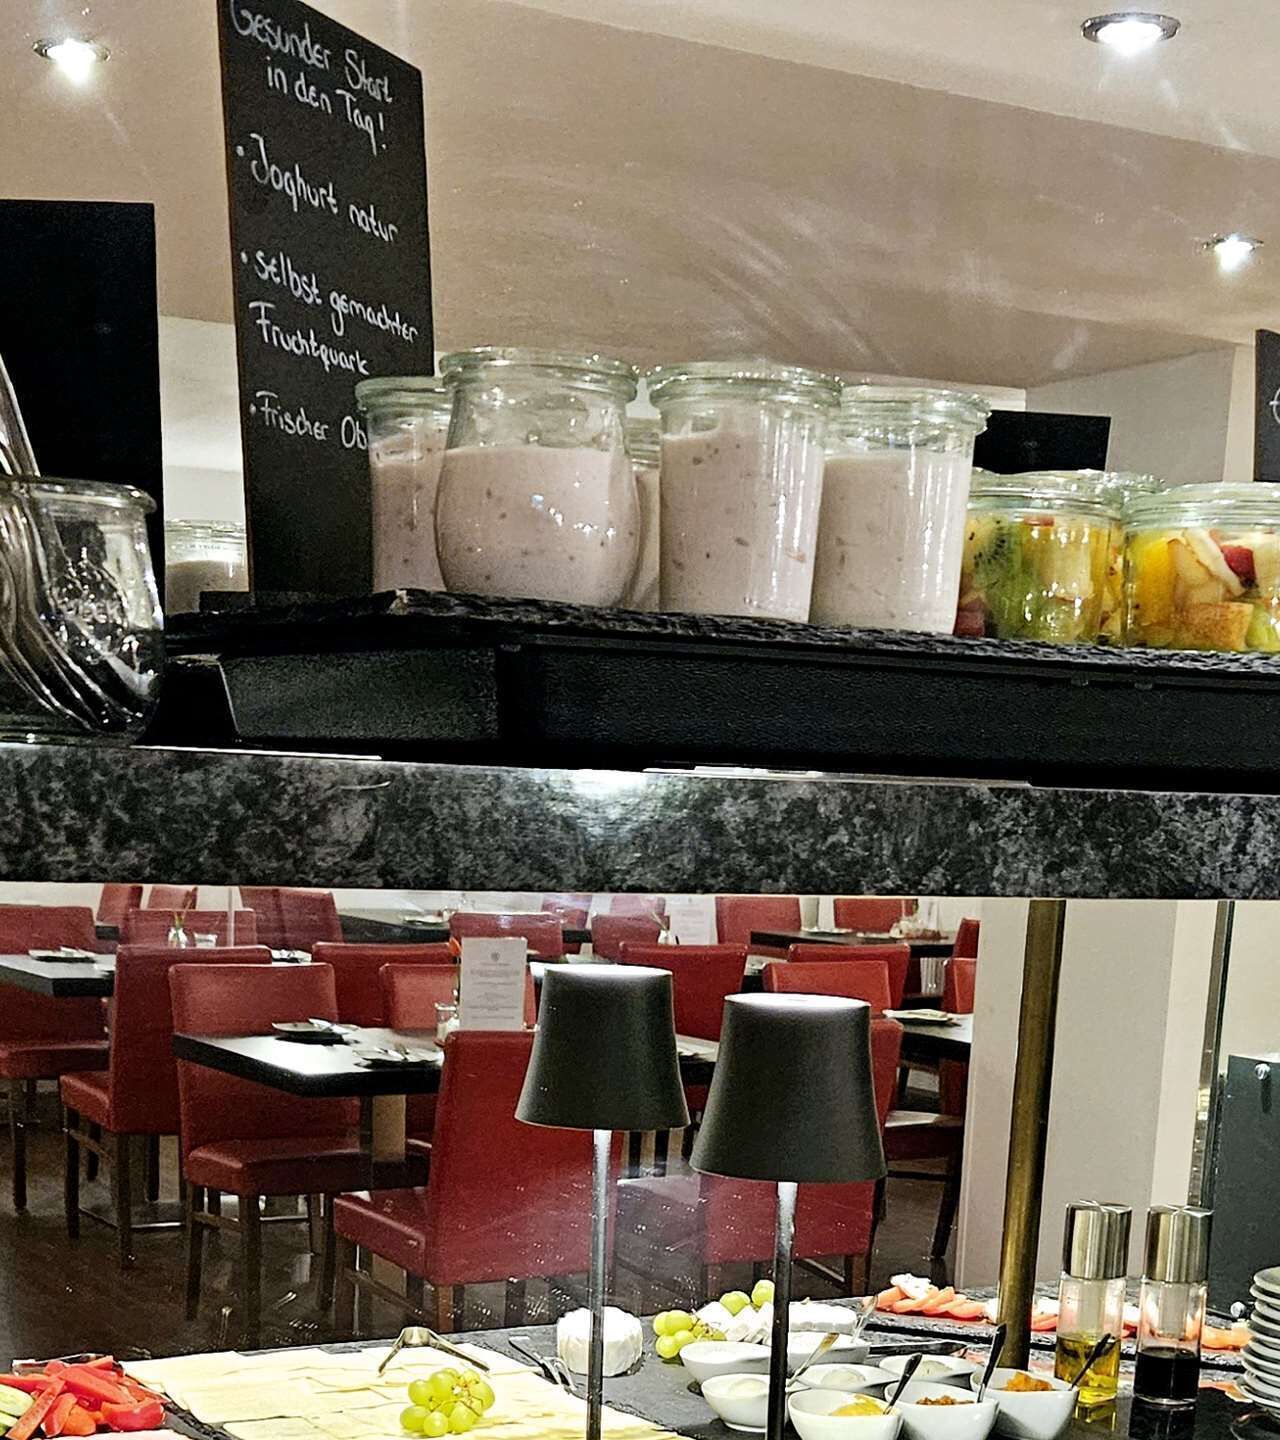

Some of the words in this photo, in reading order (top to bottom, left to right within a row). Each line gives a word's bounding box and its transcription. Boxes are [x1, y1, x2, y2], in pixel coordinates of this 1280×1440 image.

[230, 0, 331, 70] Gesunder
[344, 49, 393, 103] Start
[266, 56, 288, 94] in
[294, 72, 332, 115] den
[249, 133, 339, 213] Joghurt
[349, 203, 398, 242] natur
[248, 302, 369, 374] Fruchtquark
[330, 290, 419, 343] gemachter
[255, 391, 329, 440] Frischer
[341, 416, 368, 450] Ob
